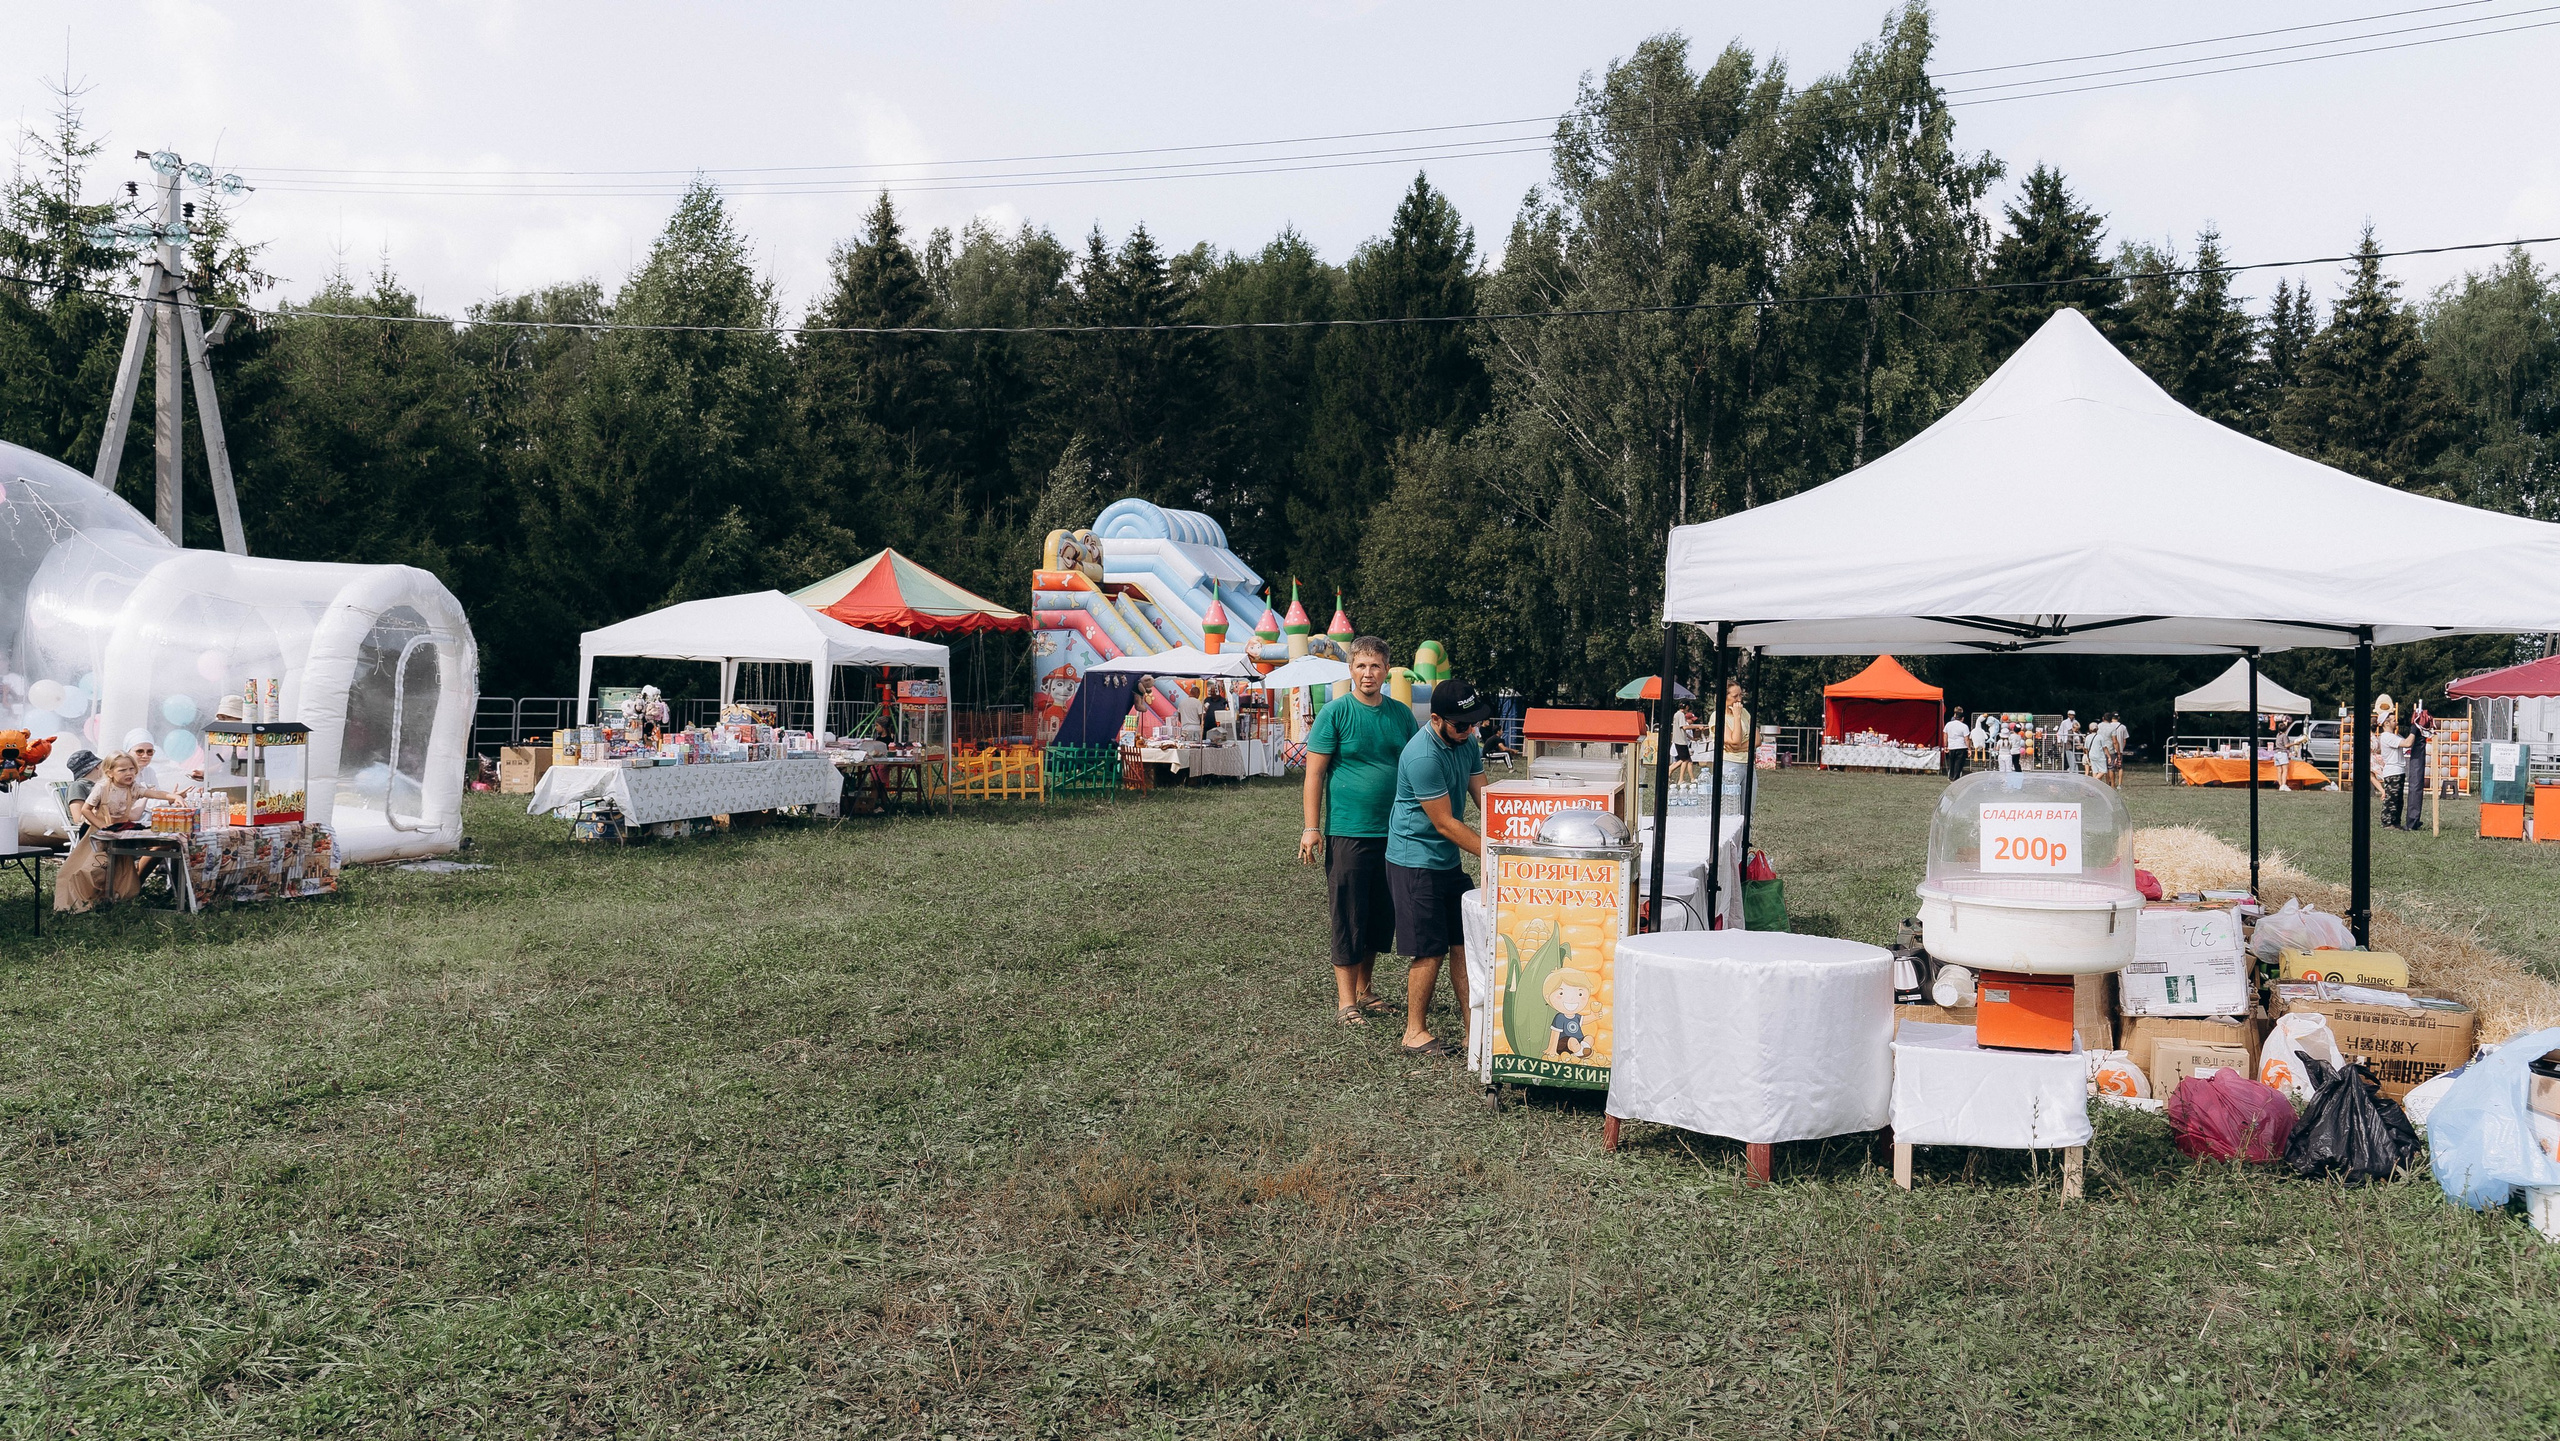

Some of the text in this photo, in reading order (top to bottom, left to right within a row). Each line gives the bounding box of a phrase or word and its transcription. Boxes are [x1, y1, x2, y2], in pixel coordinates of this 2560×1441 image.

[1983, 809, 2078, 821] СЛАДКАЯ ВАТА
[1505, 816, 1541, 837] ЯБЛ
[1994, 836, 2067, 866] 200р
[1502, 861, 1613, 883] ГОРЯЧАЯ
[1498, 887, 1618, 909] КУКУРУЗА
[2356, 973, 2395, 986] Яндекс
[2345, 1036, 2419, 1055] 大波浪薯片
[1495, 1057, 1610, 1083] КУКУРУЗКИН
[2340, 1054, 2446, 1084] 黑胡椒牛
